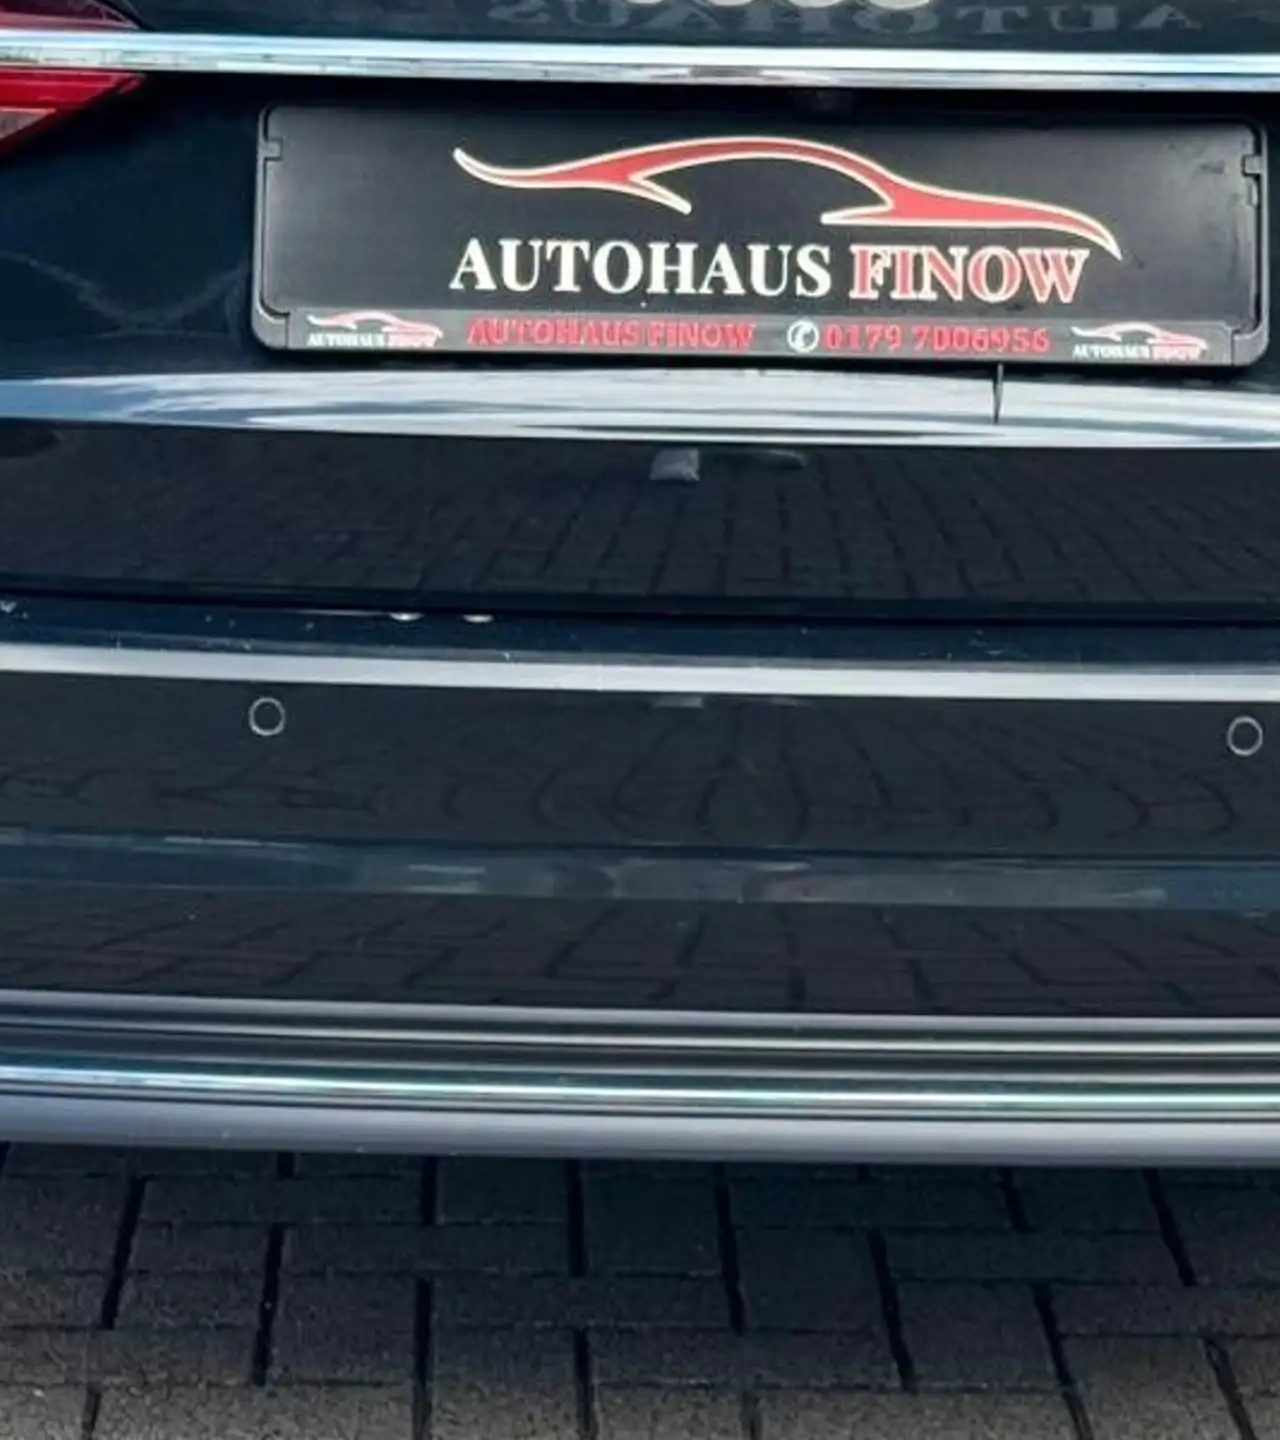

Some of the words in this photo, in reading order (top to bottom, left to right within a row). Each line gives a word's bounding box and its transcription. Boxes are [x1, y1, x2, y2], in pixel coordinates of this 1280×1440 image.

[448, 237, 832, 298] AUTOHAUS
[848, 243, 1090, 304] FINOW
[466, 316, 639, 349] AUTOHAUS
[646, 320, 757, 352] FINOW
[823, 323, 902, 352] 0179
